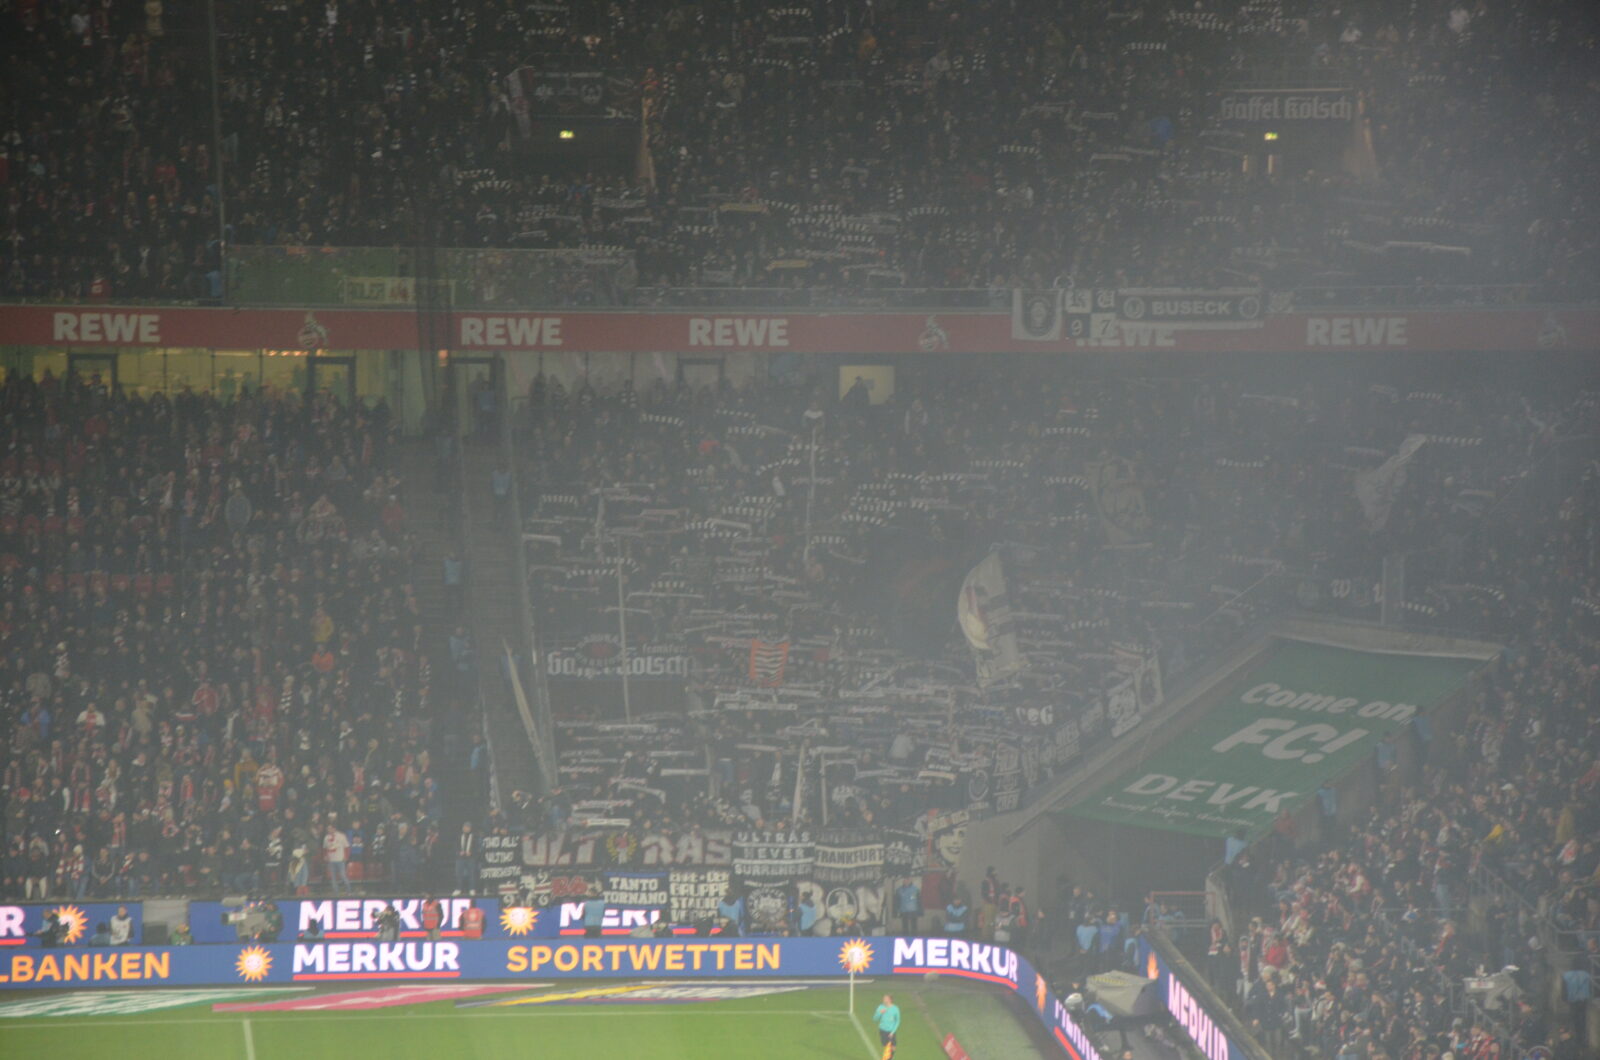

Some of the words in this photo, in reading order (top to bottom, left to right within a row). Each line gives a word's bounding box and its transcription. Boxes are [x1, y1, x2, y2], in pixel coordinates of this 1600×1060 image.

[1152, 300, 1232, 315] BUSECK
[53, 312, 161, 343] REWE
[460, 317, 563, 346] REWE
[688, 318, 789, 347] REWE
[1306, 317, 1408, 346] REWE
[1241, 682, 1358, 714] Come
[1357, 700, 1417, 725] on
[1212, 718, 1370, 764] FC!
[1122, 773, 1300, 814] DEVK
[737, 831, 811, 843] ULTRAS
[609, 876, 659, 892] TANTO
[292, 941, 460, 974] MERKUR
[506, 943, 782, 973] SPORTWETTEN
[892, 937, 1018, 983] MERKUR
